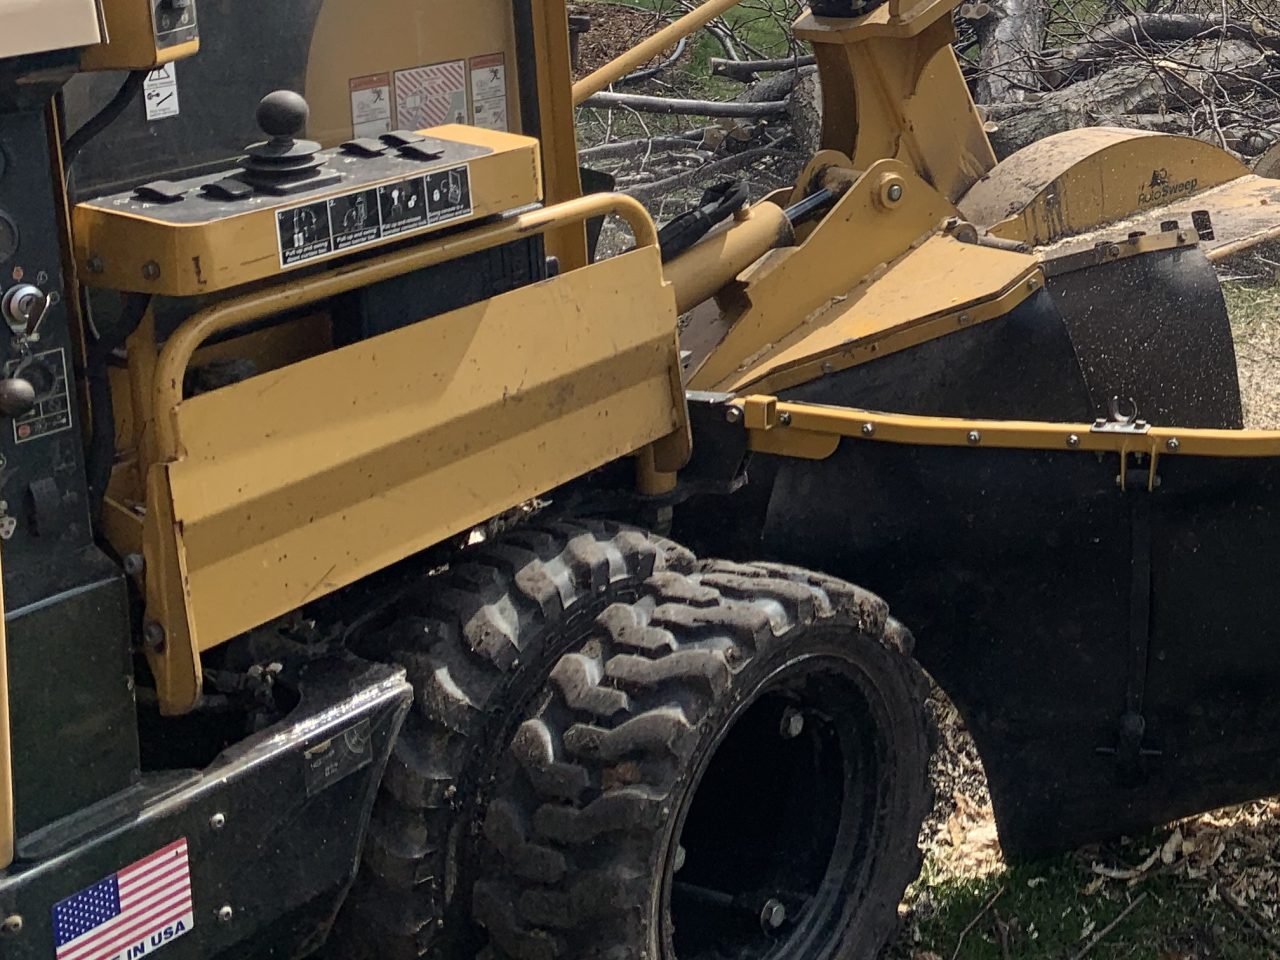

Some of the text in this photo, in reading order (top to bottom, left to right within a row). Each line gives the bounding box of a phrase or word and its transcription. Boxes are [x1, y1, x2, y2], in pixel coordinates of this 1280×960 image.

[1137, 178, 1198, 206] AutoSweep
[127, 920, 186, 960] IN USA
